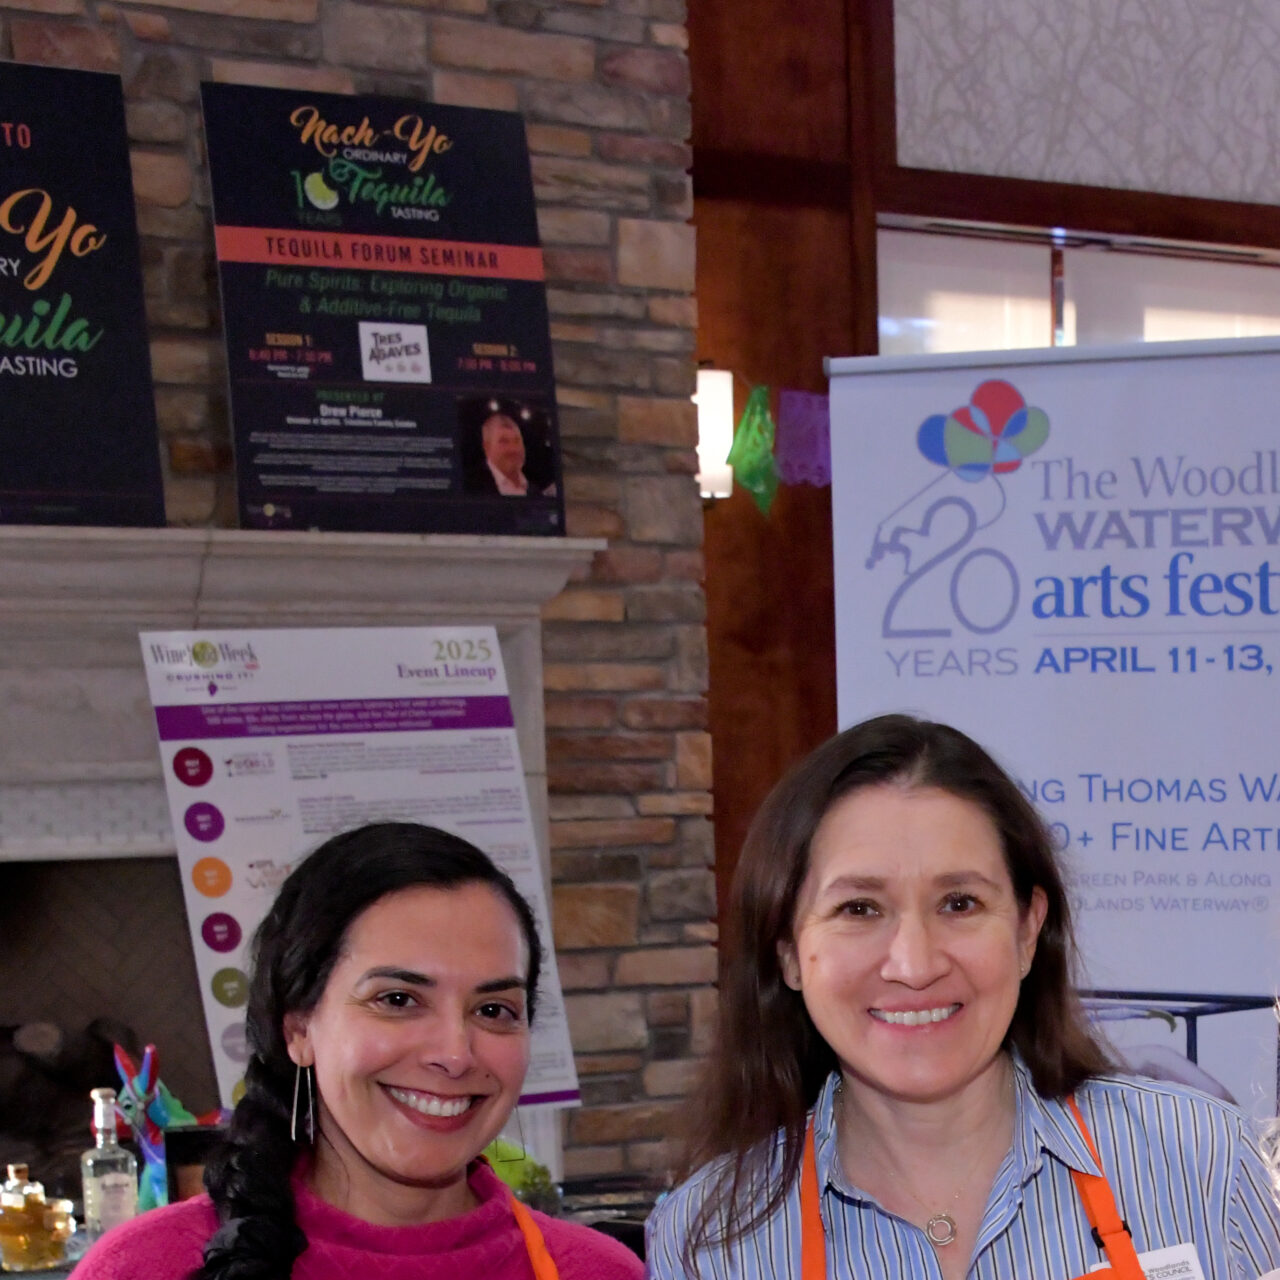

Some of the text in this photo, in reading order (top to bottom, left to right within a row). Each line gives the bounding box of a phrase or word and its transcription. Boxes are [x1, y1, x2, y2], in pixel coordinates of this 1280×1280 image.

[2, 123, 31, 148] TO
[343, 149, 407, 164] ORDINARY
[330, 157, 449, 215] Tequila
[391, 207, 440, 222] TASTING
[266, 237, 499, 270] TEQUILA FORUM SEMINAR
[371, 332, 402, 348] TRES
[369, 343, 422, 366] AGAVES
[1031, 457, 1118, 501] The
[880, 496, 1021, 640] 20
[1031, 565, 1151, 620] arts
[432, 638, 493, 662] 2025
[885, 647, 1019, 678] YEARS
[1033, 646, 1156, 675] APRIL
[397, 663, 497, 683] Event Lineup
[1078, 773, 1227, 803] THOMAS
[1112, 822, 1189, 852] FINE
[1133, 870, 1181, 888] PARK
[1205, 870, 1271, 888] ALONG
